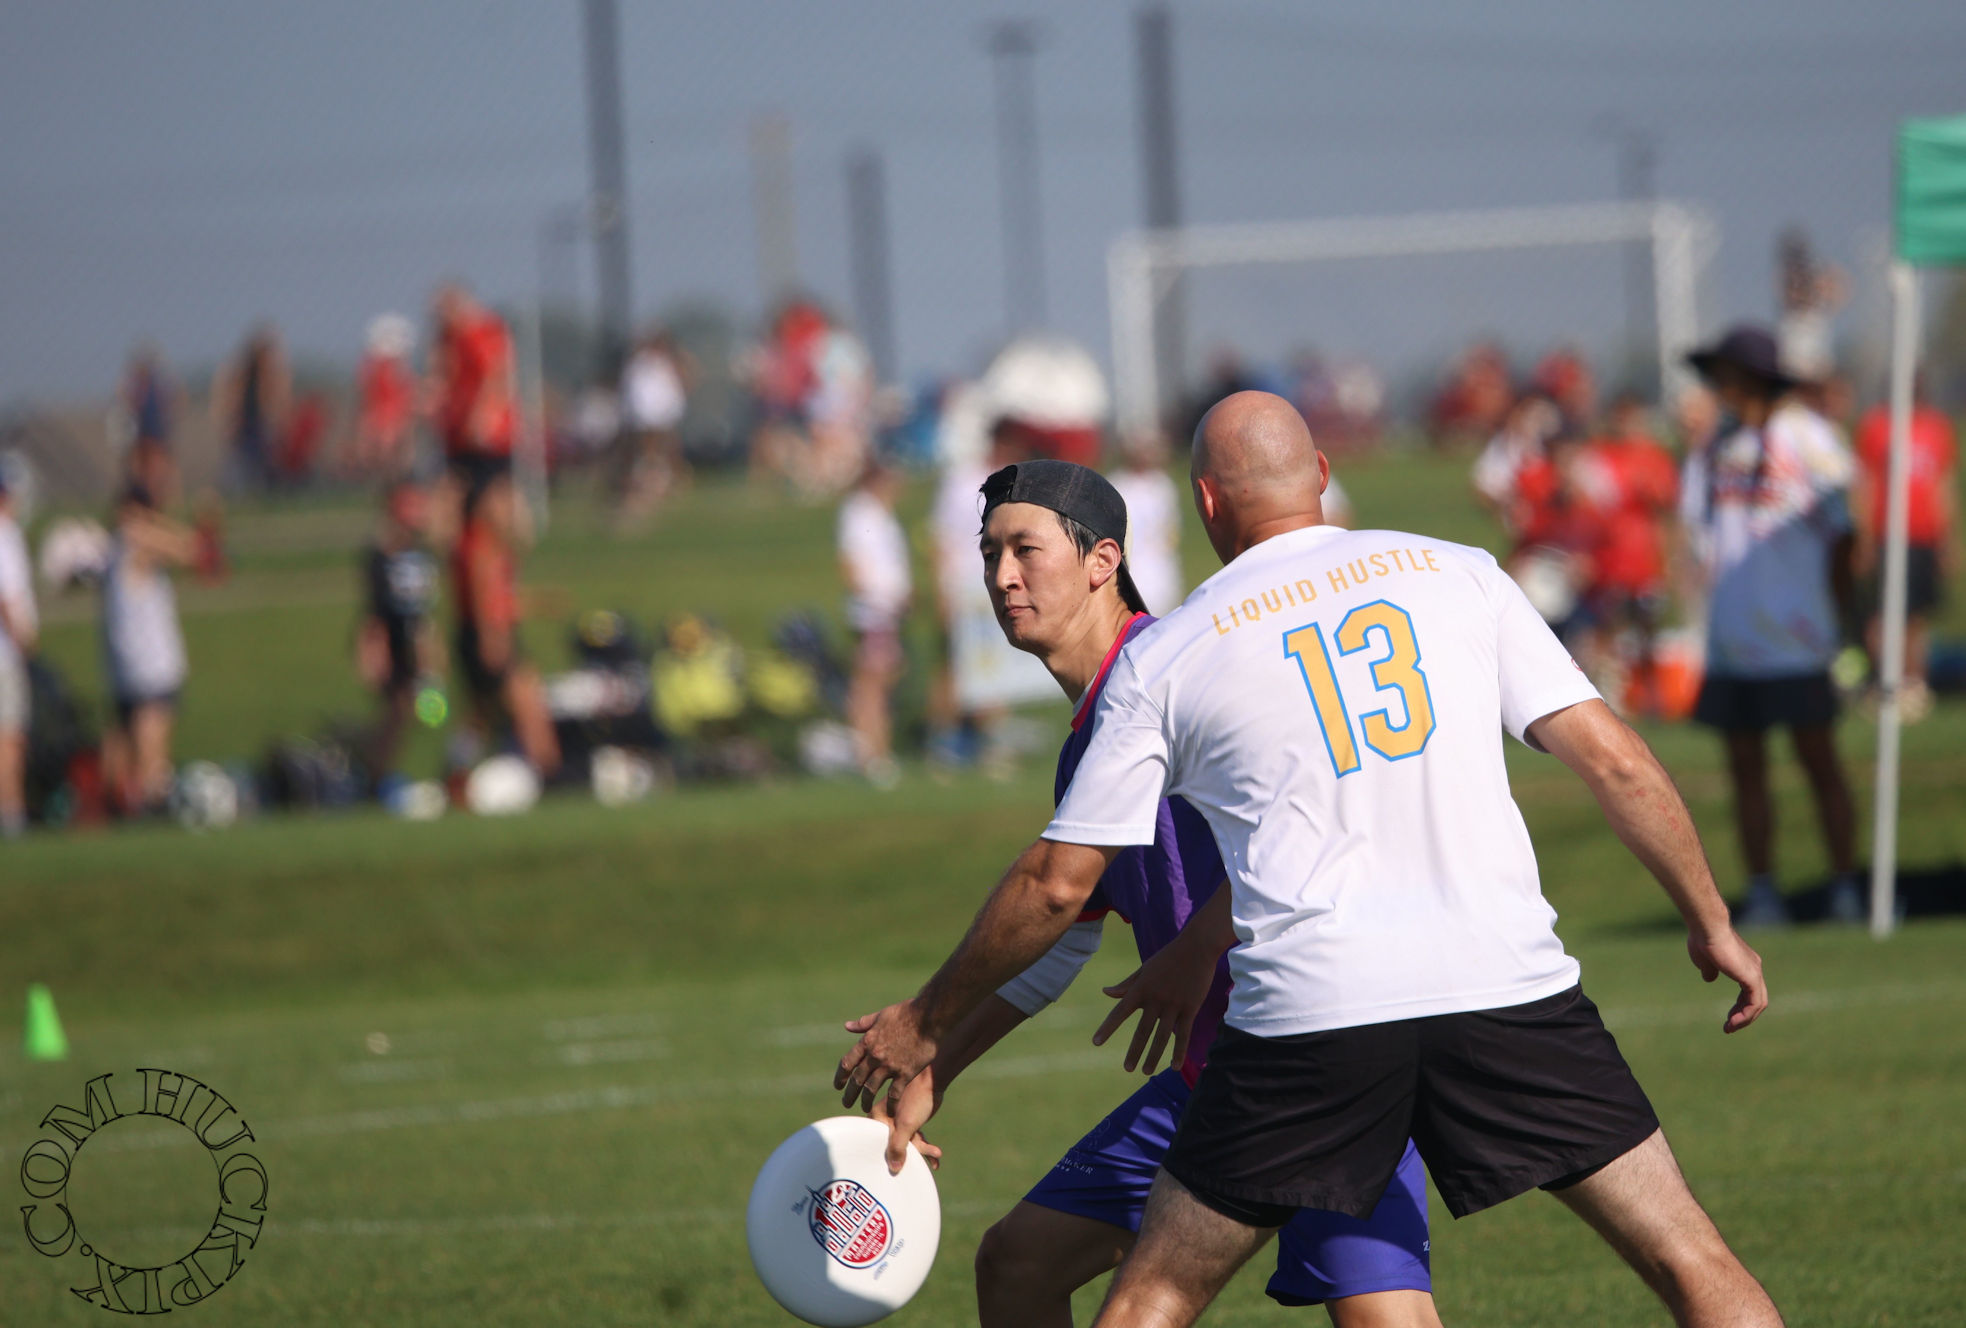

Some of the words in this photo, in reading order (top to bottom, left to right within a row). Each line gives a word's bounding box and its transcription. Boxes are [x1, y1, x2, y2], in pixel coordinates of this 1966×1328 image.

[1212, 579, 1318, 636] LIQUID
[1326, 548, 1441, 594] HUSTLE
[1282, 598, 1437, 779] 13
